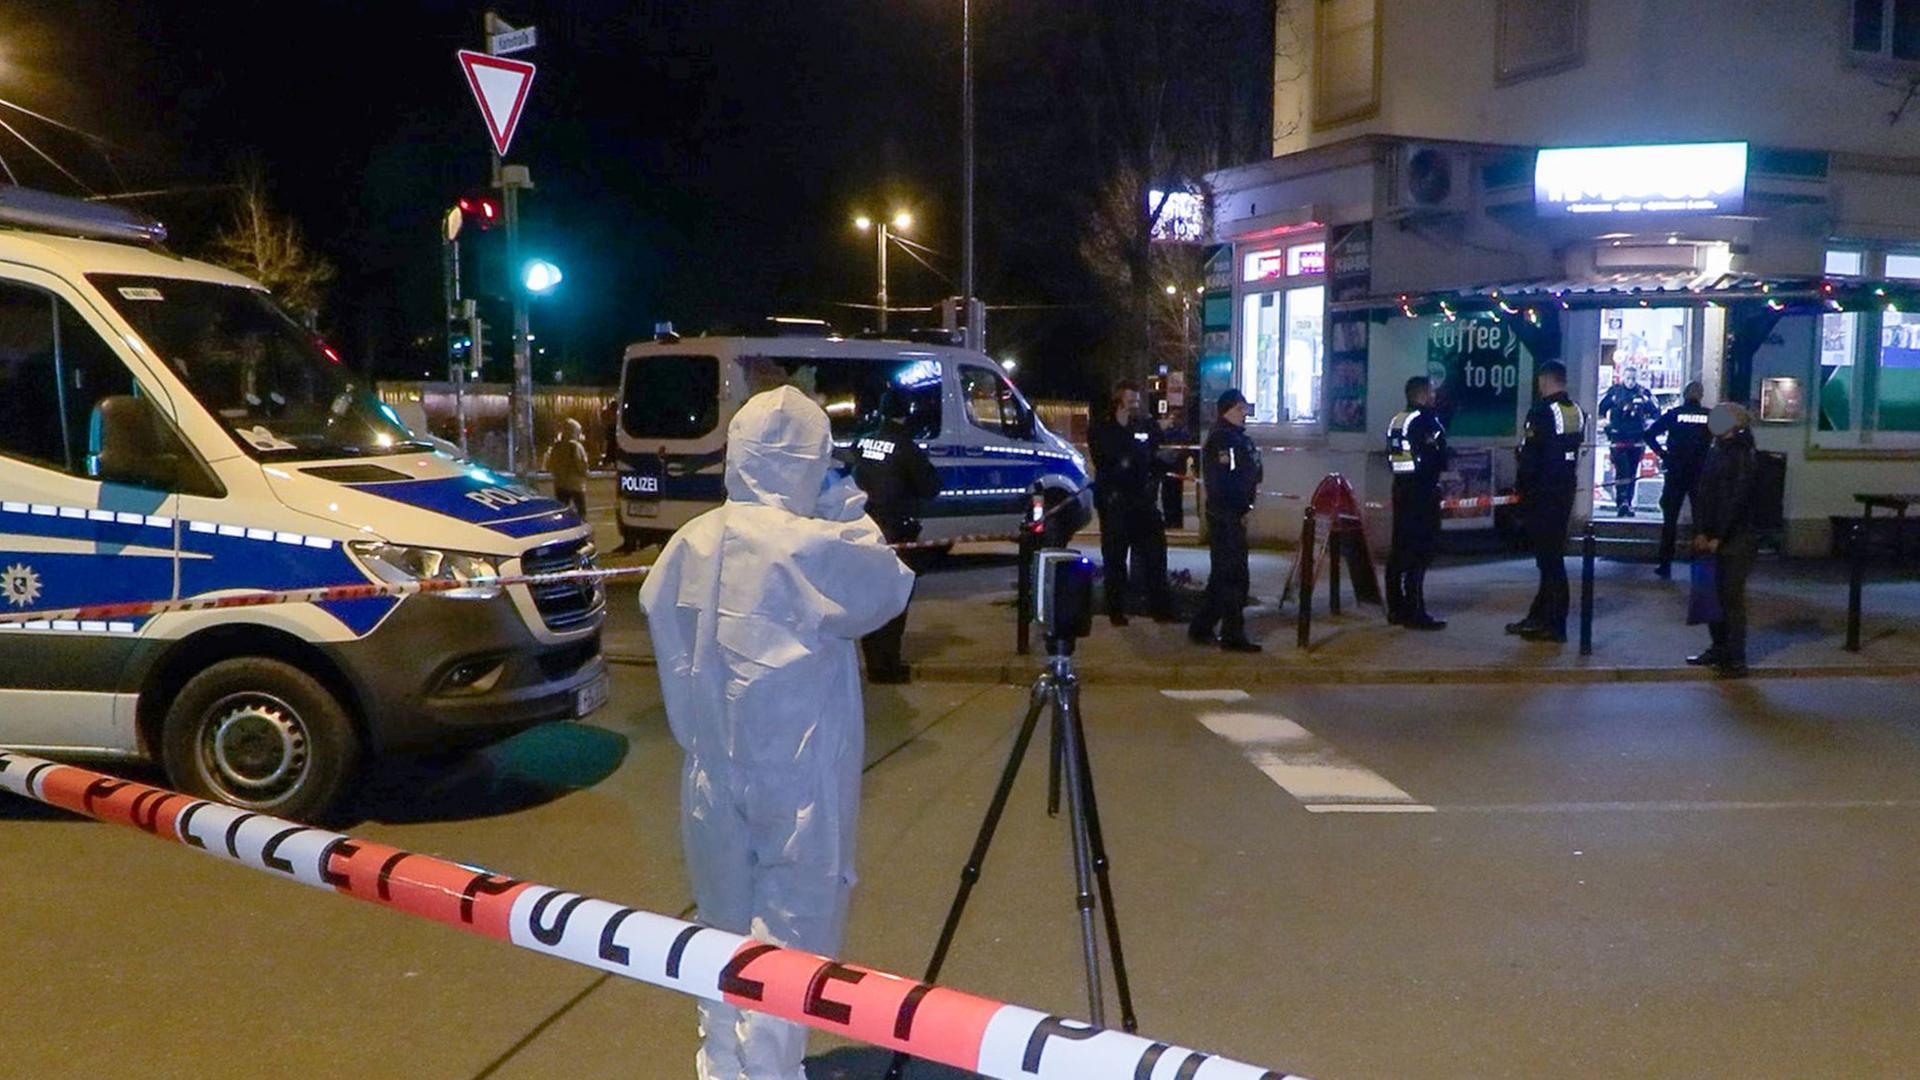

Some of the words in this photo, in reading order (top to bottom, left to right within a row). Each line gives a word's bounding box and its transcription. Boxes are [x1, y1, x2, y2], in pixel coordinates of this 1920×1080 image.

[1433, 319, 1501, 353] coffee
[1464, 360, 1486, 388] to
[1490, 364, 1516, 395] go
[857, 438, 895, 454] POLIZEI
[621, 476, 658, 492] POLIZEI
